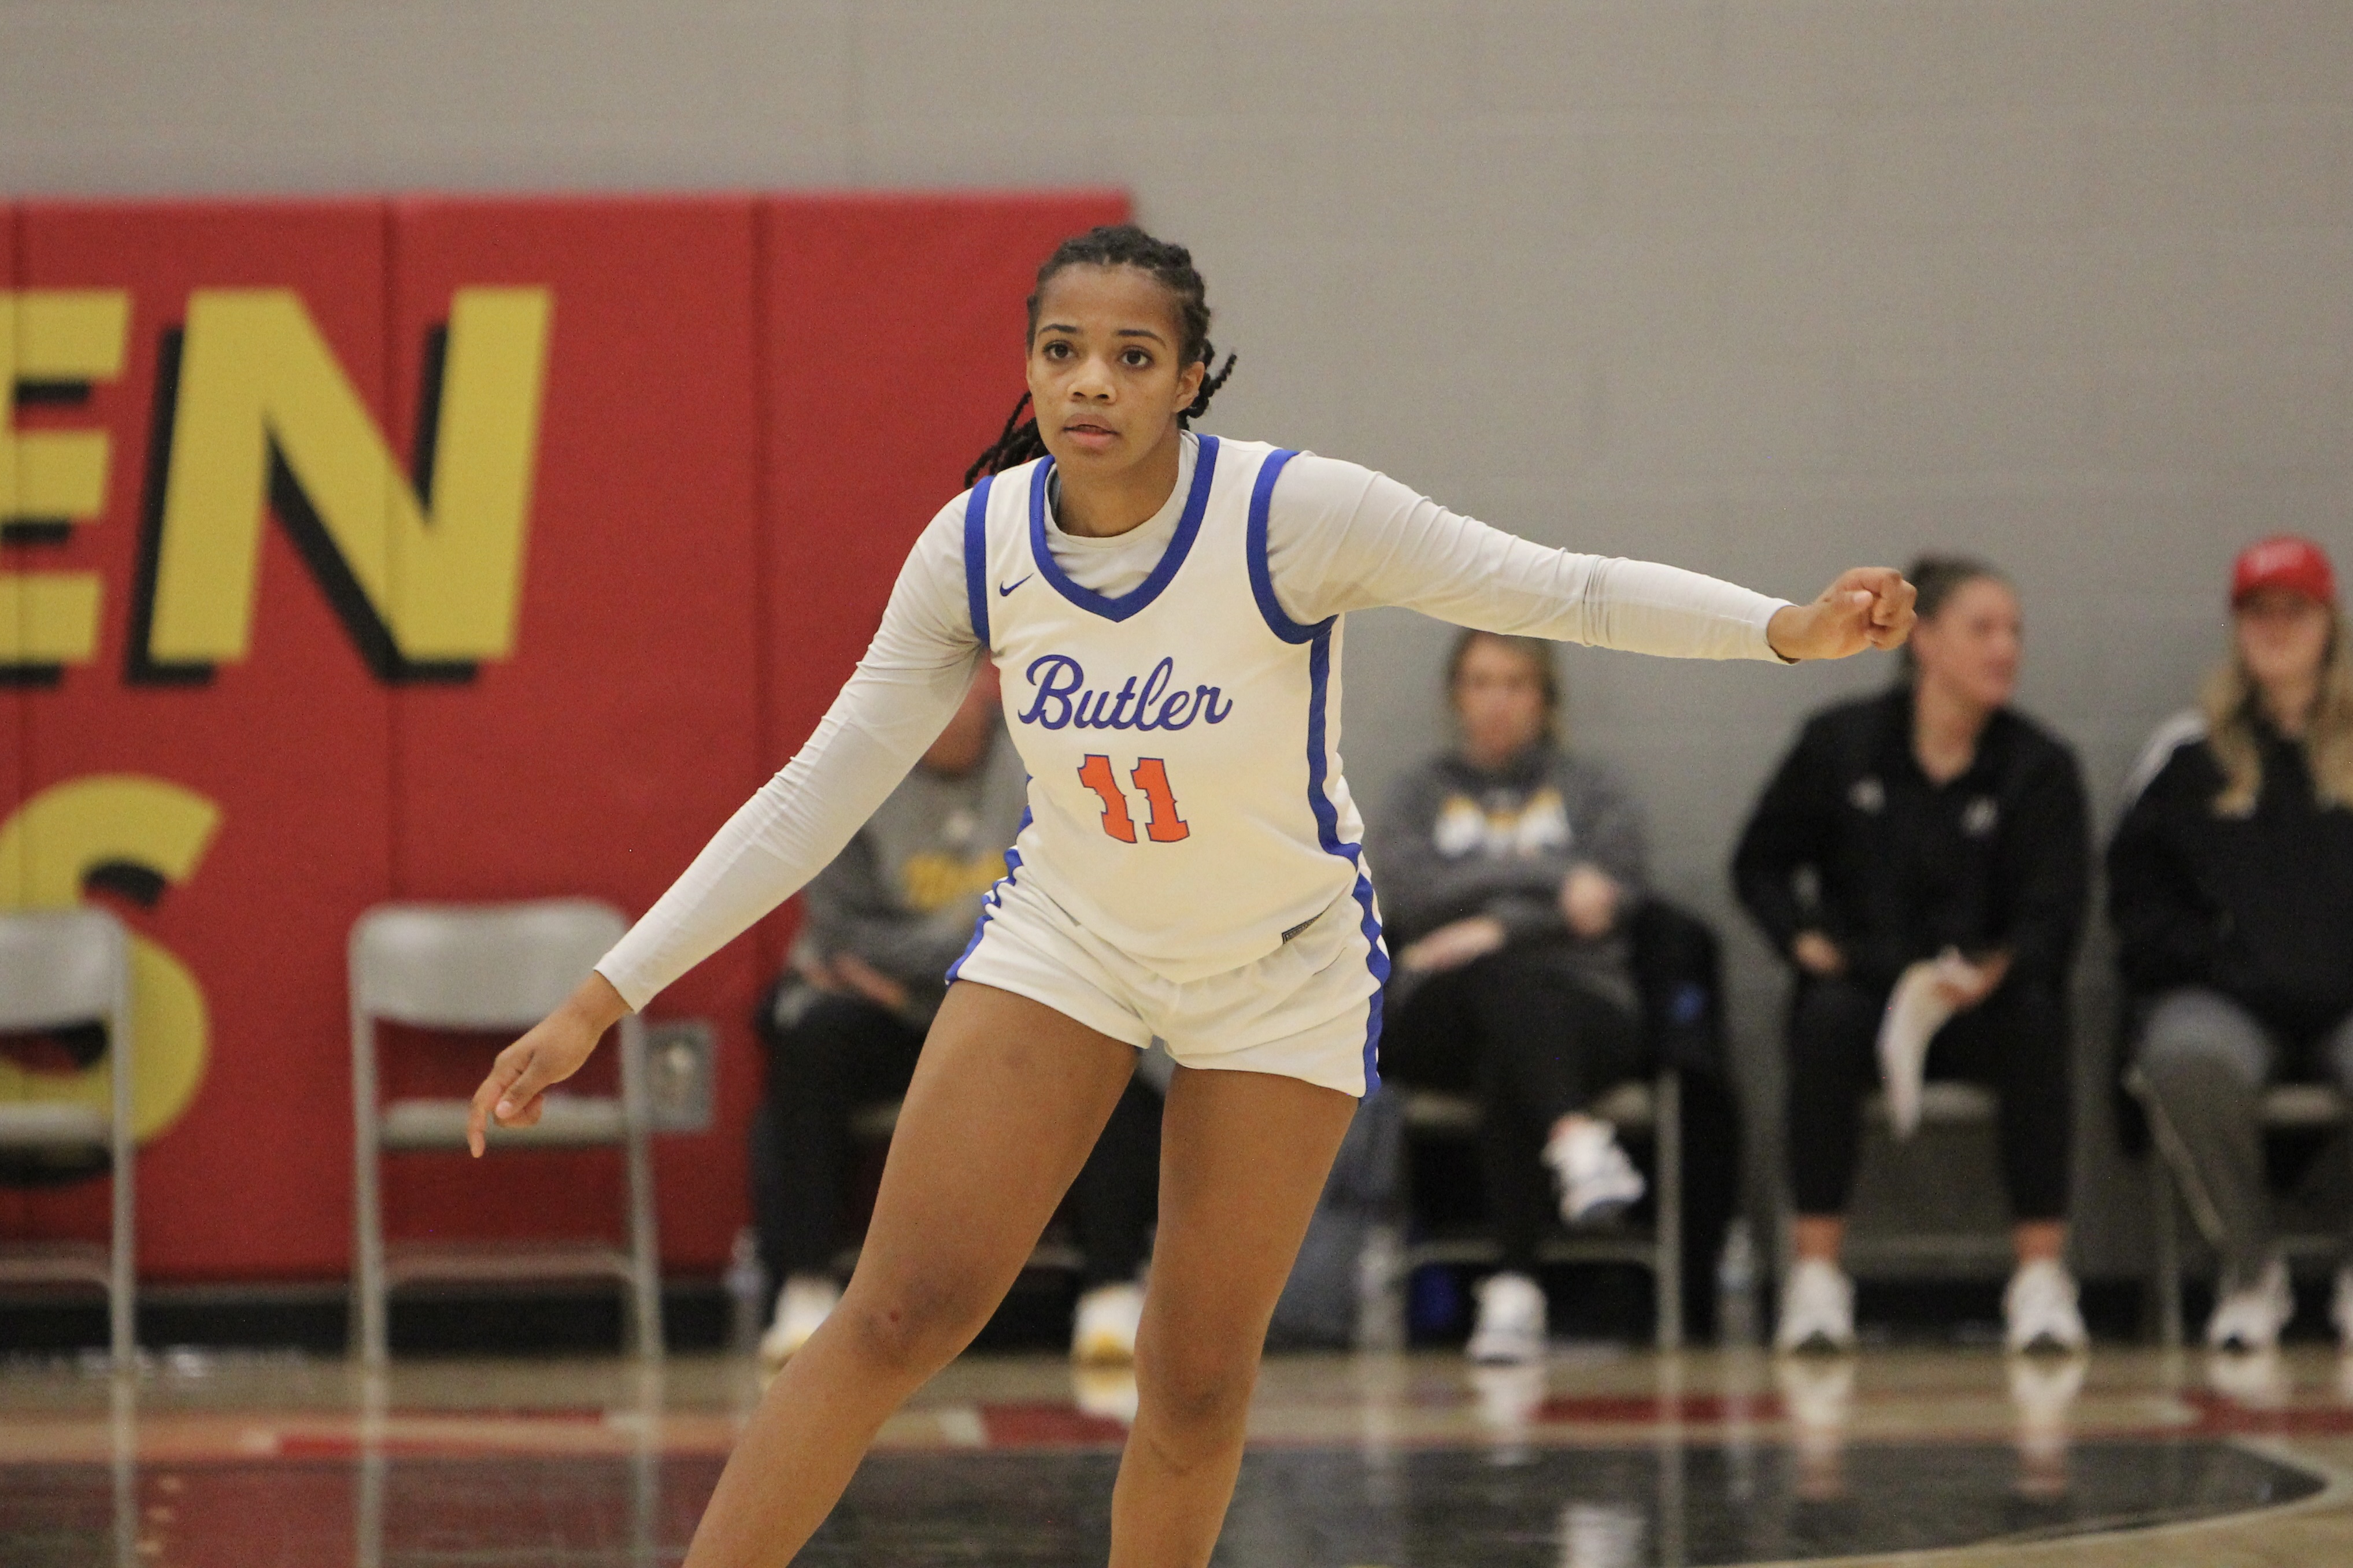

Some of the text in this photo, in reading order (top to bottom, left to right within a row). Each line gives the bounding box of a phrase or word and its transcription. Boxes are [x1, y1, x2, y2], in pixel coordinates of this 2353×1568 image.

[0, 284, 553, 675] EN
[1018, 654, 1233, 731] Butler
[1077, 754, 1190, 844] 11
